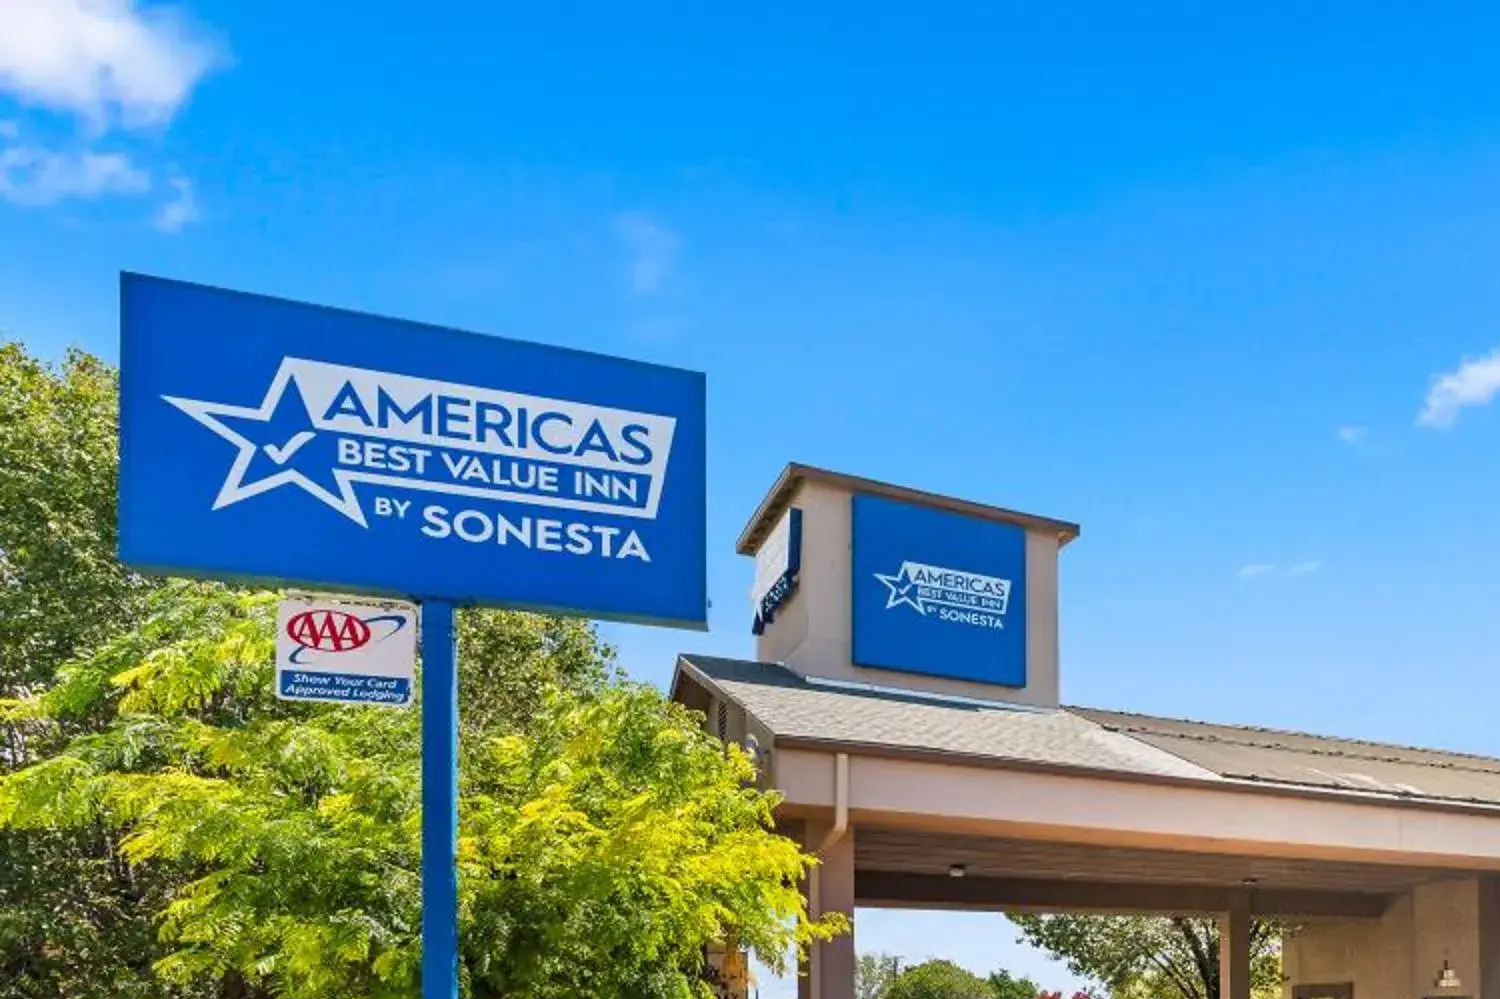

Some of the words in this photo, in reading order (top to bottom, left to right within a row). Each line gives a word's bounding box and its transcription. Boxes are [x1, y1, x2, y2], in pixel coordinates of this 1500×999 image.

[322, 379, 653, 465] AMERICAS
[337, 437, 432, 475] BEST
[441, 451, 559, 492] VALUE
[574, 470, 637, 502] INN
[374, 496, 411, 519] BY
[420, 504, 652, 562] SONESTA
[915, 568, 1005, 596] AMERICAS
[945, 591, 977, 604] VALUE
[981, 597, 1001, 609] INN
[293, 610, 364, 652] AAA
[939, 608, 1003, 628] SONESTA
[285, 684, 351, 698] Approved
[353, 688, 405, 701] Lodging
[293, 673, 331, 686] Show
[334, 676, 365, 687] Your
[367, 678, 398, 689] Card
